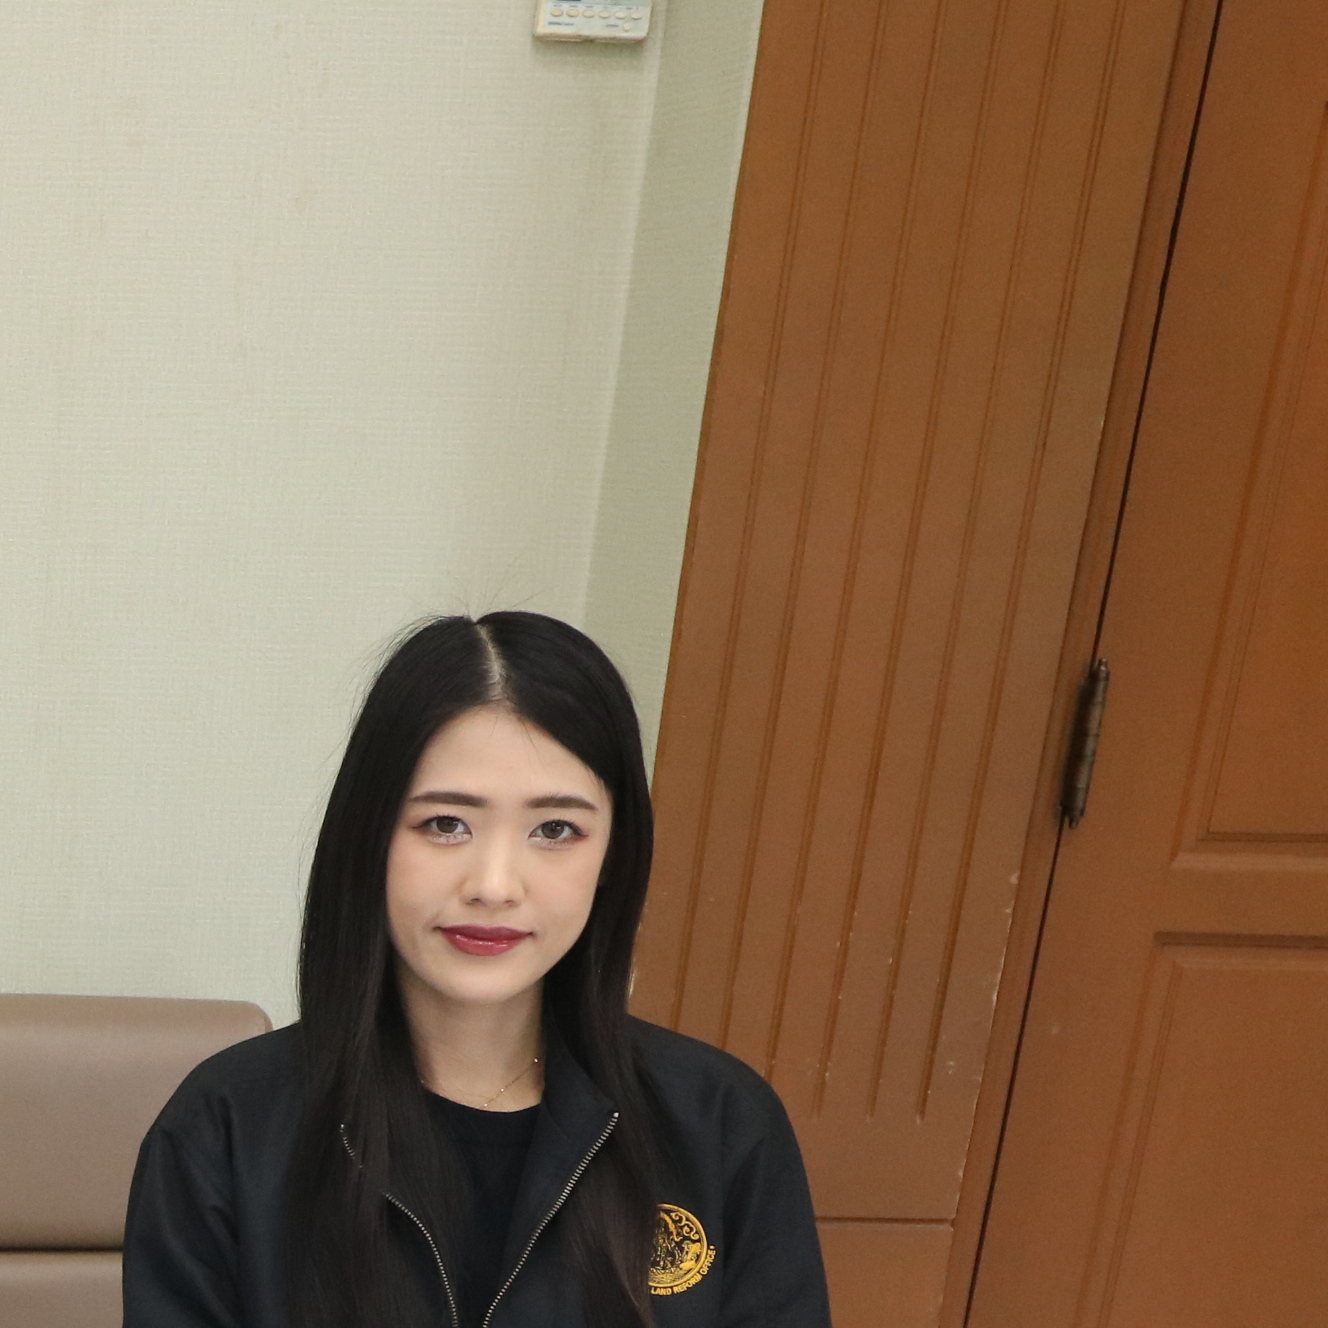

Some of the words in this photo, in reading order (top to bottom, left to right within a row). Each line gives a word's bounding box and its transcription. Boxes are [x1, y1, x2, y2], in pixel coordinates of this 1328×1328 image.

[651, 1287, 672, 1296] LAND
[673, 1273, 703, 1294] REFORM
[700, 1248, 716, 1275] OFFICE
